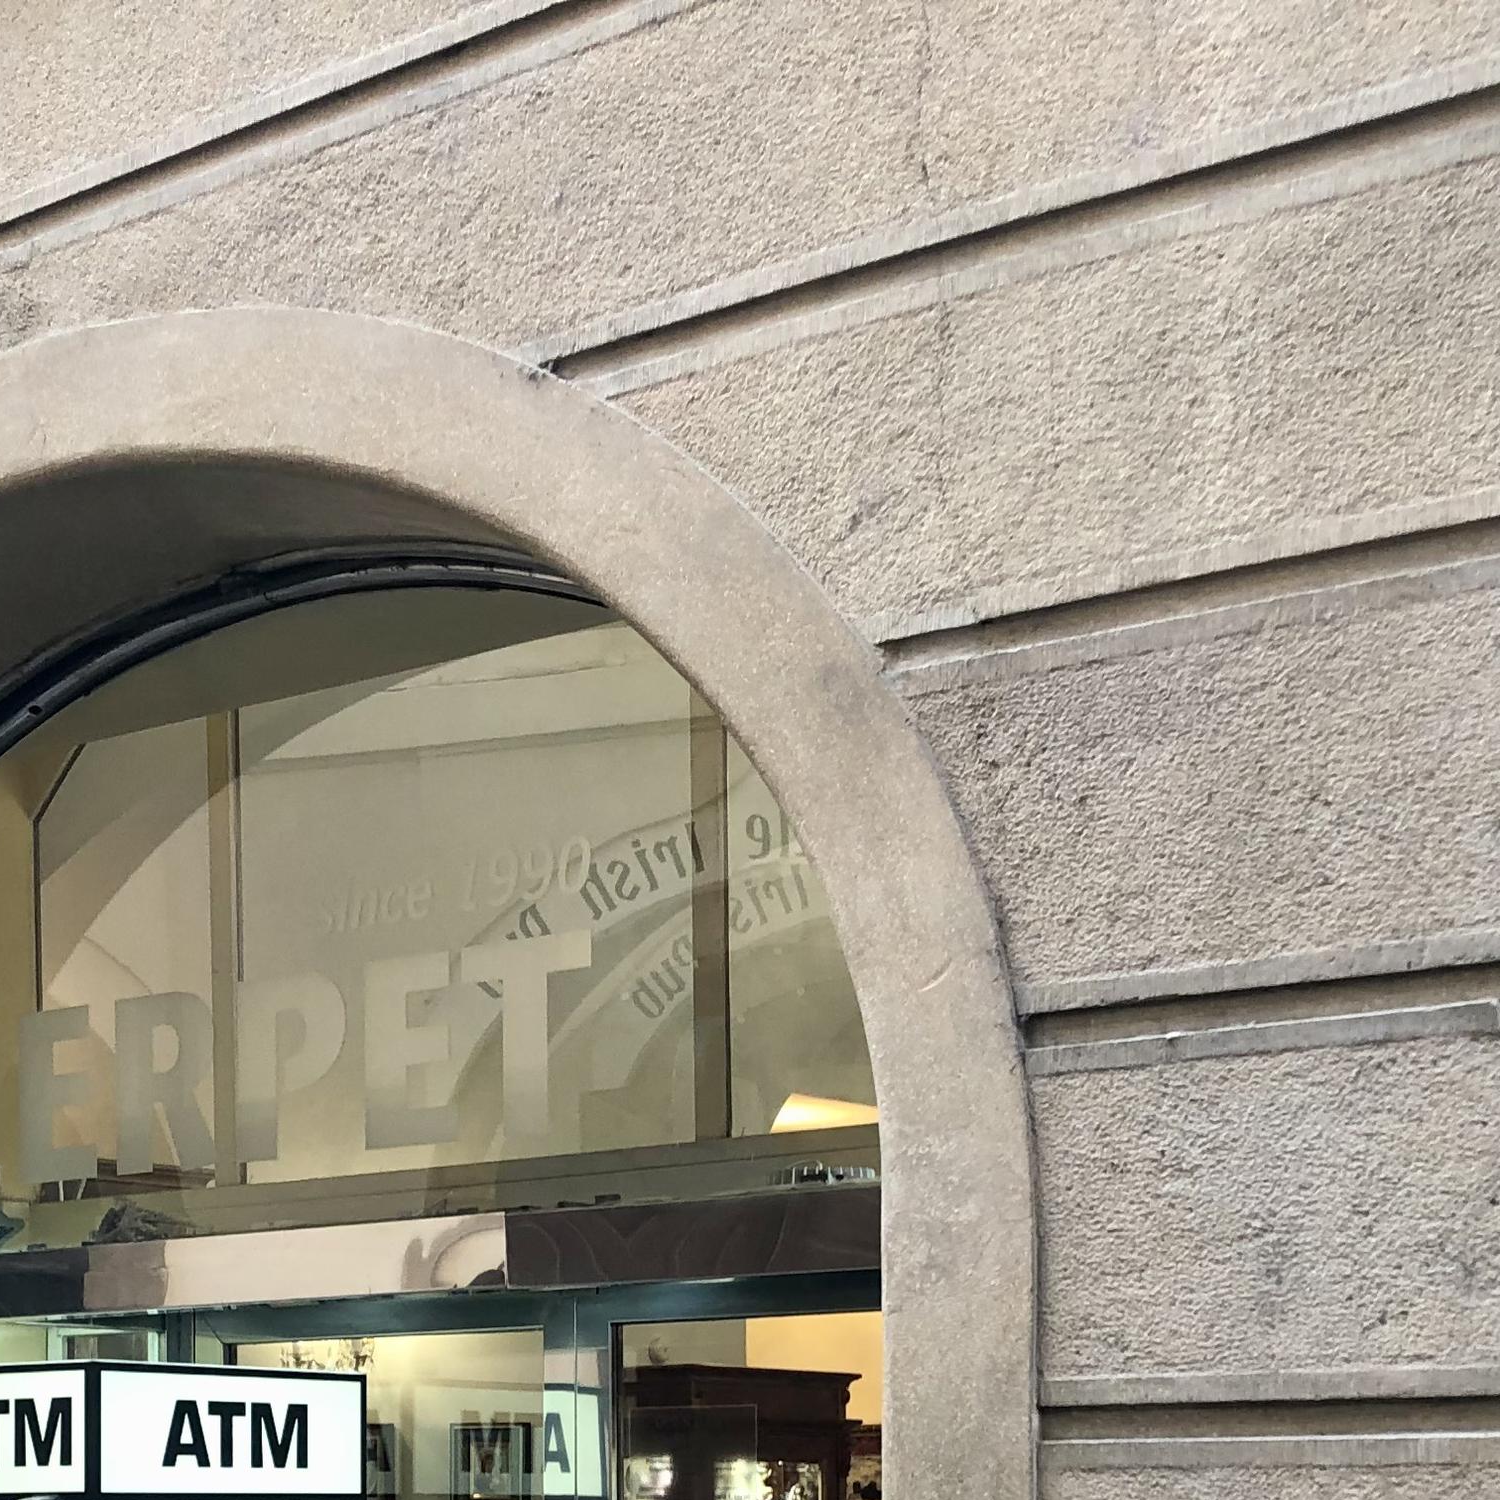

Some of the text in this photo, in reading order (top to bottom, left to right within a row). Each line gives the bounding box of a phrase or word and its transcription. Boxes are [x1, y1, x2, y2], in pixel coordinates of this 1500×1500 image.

[463, 834, 593, 912] 1990
[20, 930, 593, 1184] ERPET
[162, 1399, 309, 1469] ATM
